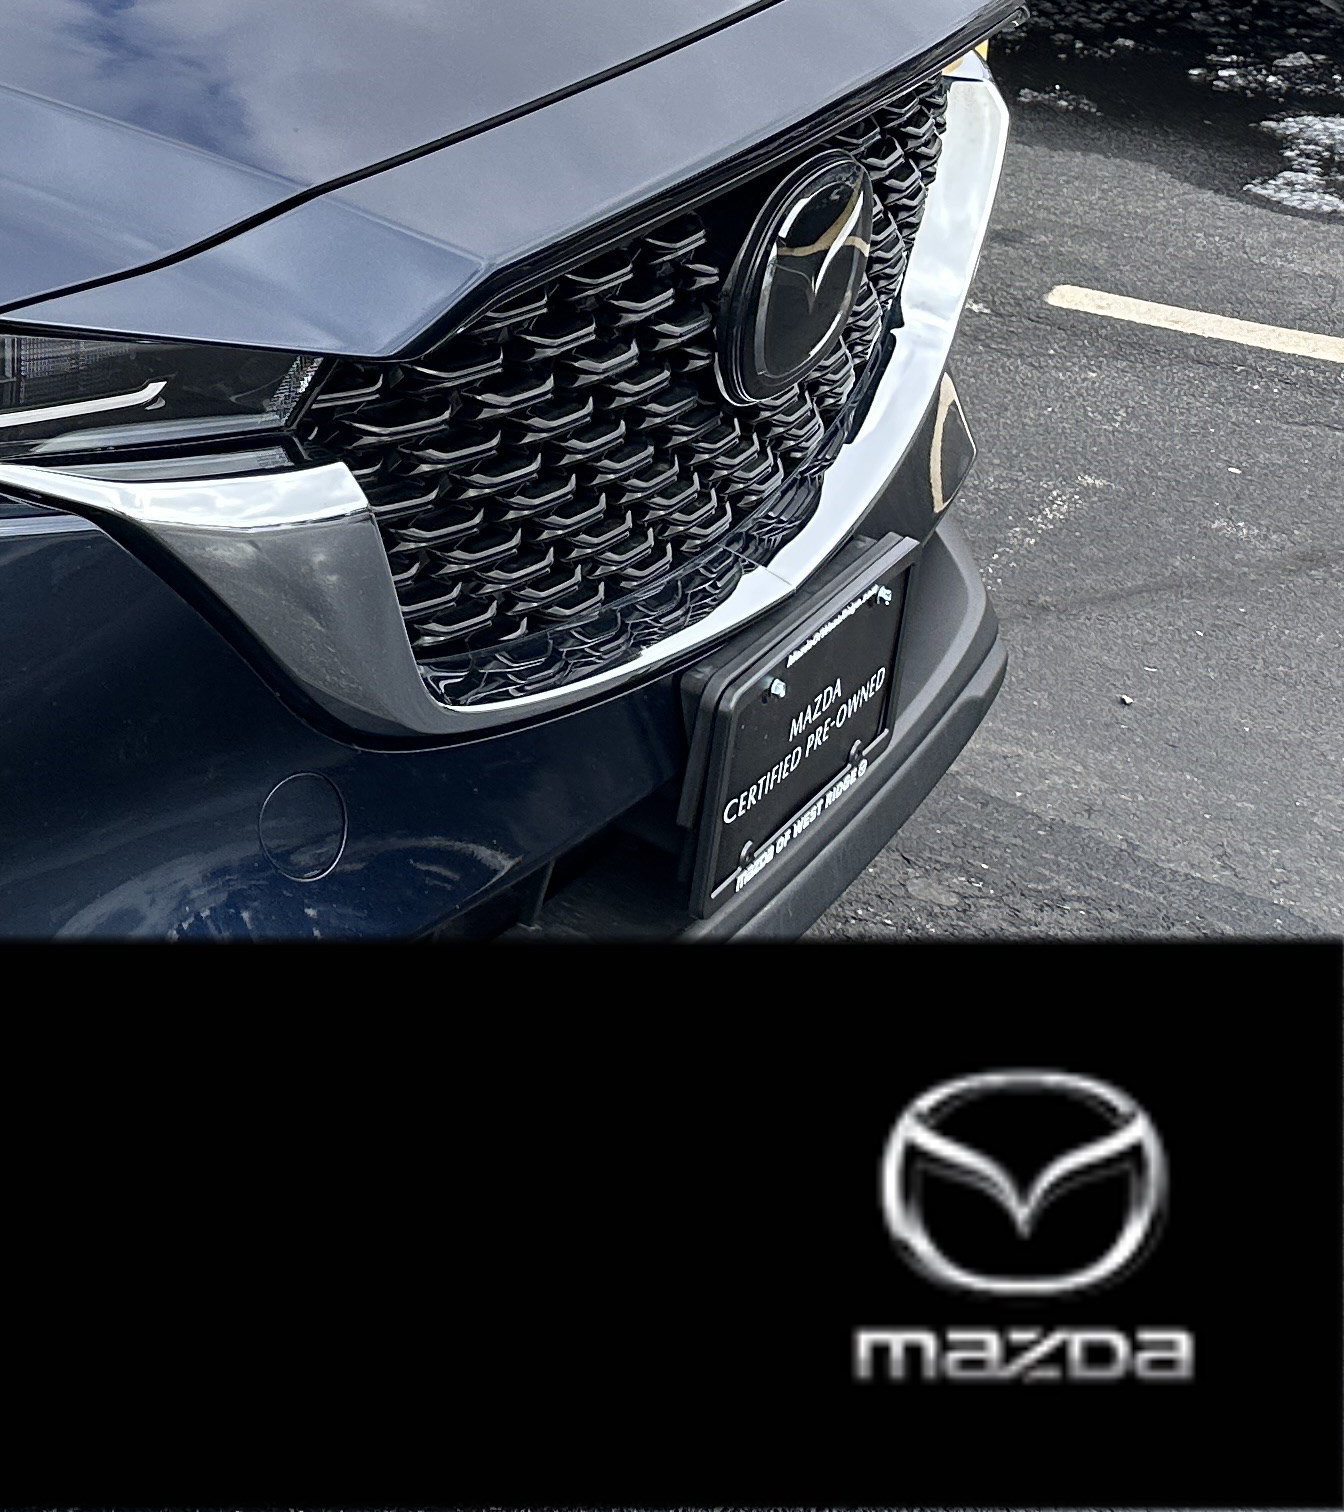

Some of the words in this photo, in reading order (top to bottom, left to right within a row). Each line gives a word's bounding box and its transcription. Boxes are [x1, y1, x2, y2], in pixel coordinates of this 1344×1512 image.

[723, 745, 802, 824] CERTIFIED
[805, 666, 886, 758] PRE-OWNED
[789, 678, 842, 742] MAZDA
[775, 828, 791, 854] OF
[792, 798, 824, 839] WEST
[824, 767, 858, 809] RIDGE
